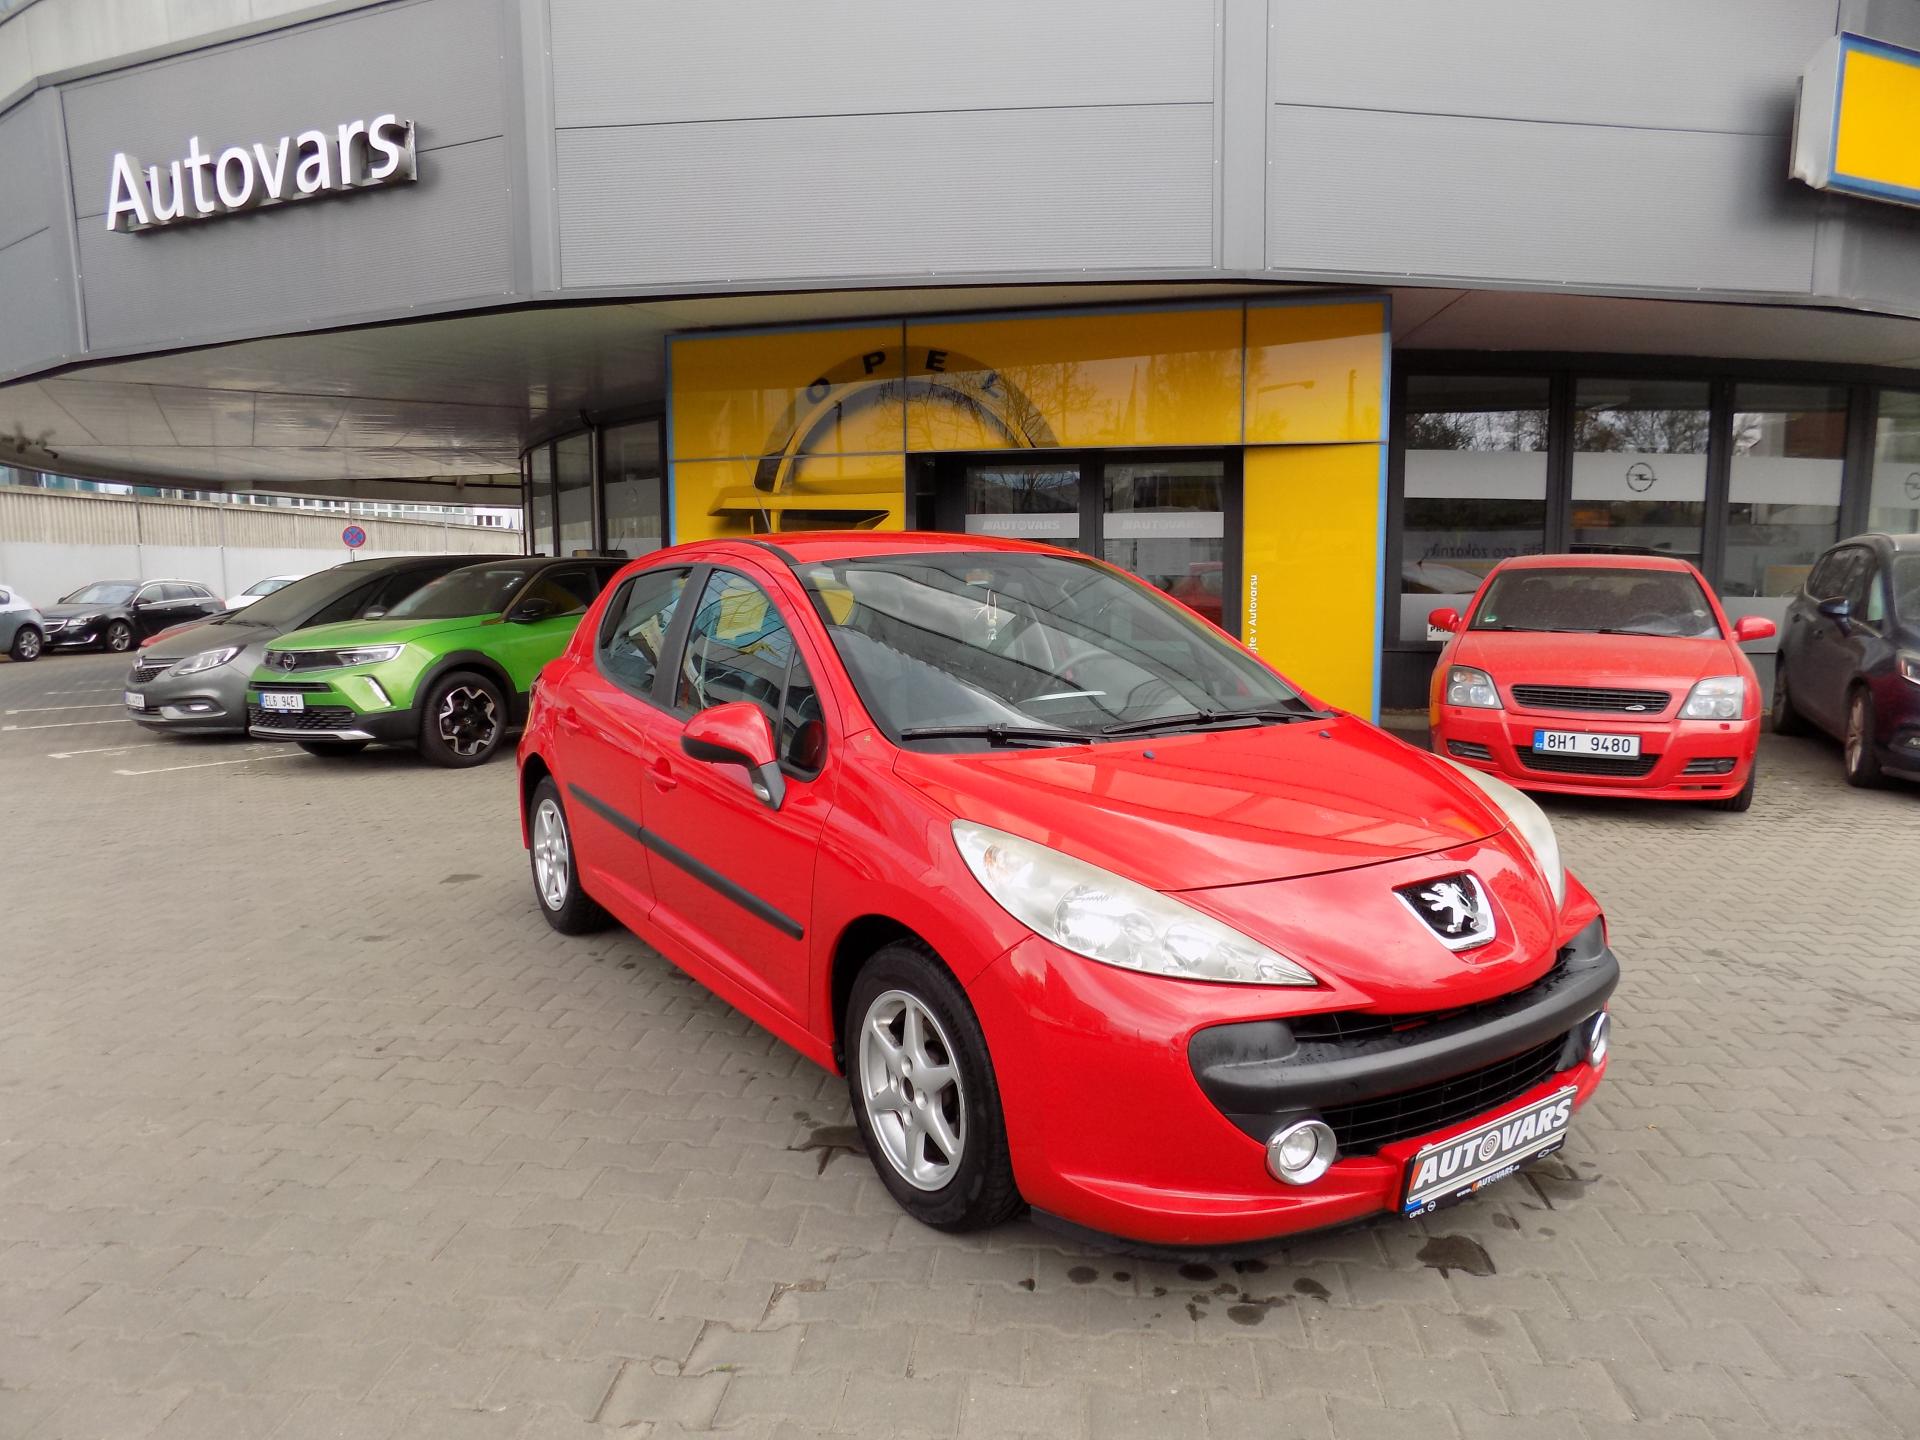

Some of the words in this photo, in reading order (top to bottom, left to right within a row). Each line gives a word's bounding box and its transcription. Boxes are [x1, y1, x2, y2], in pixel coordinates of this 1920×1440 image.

[106, 113, 400, 231] Autovars
[806, 350, 1006, 405] OPEL
[1248, 574, 1258, 627] Autovarsu
[1248, 637, 1259, 654] jte
[1547, 734, 1576, 751] 8H1
[1590, 736, 1632, 753] 9480
[1413, 1098, 1572, 1190] AUTOVARS
[1408, 1207, 1426, 1219] OPEL
